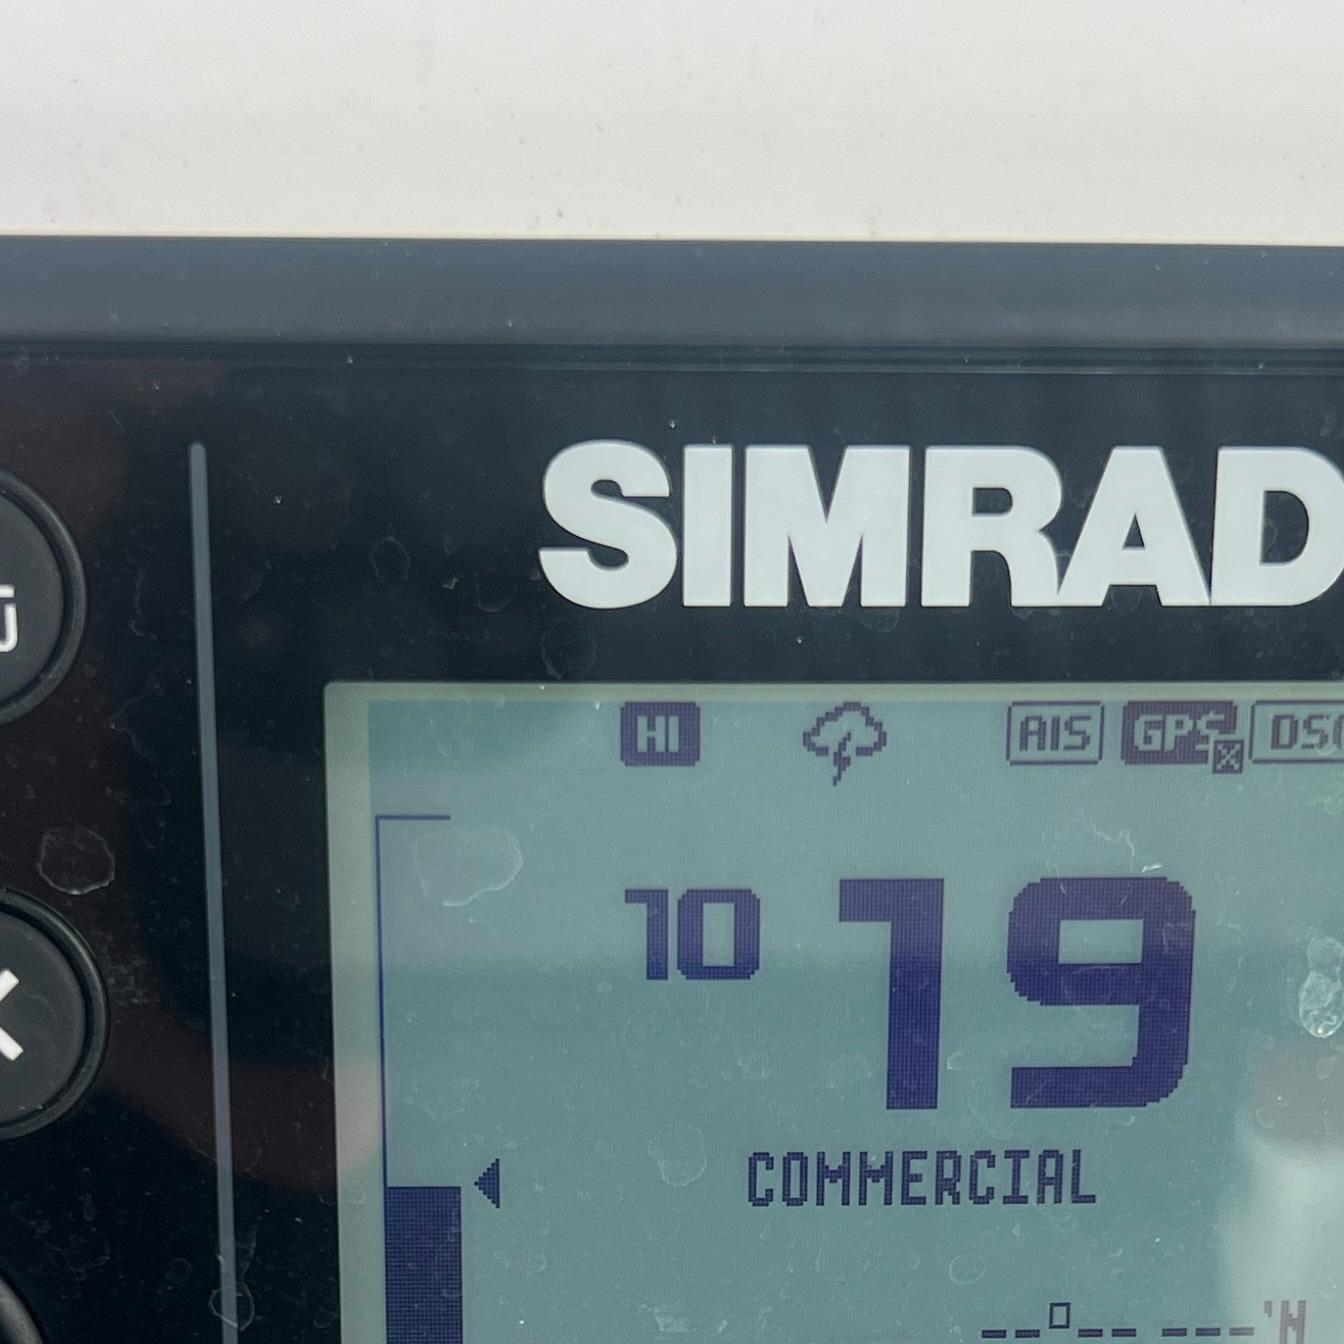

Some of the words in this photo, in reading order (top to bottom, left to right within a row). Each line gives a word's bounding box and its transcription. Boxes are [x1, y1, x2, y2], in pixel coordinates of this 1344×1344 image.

[636, 715, 680, 754] HI
[1019, 714, 1092, 751] AIS
[1133, 714, 1226, 751] GPS
[624, 888, 761, 981] 10
[838, 876, 1197, 1110] 19
[747, 1148, 1098, 1208] COMMERCIAL
